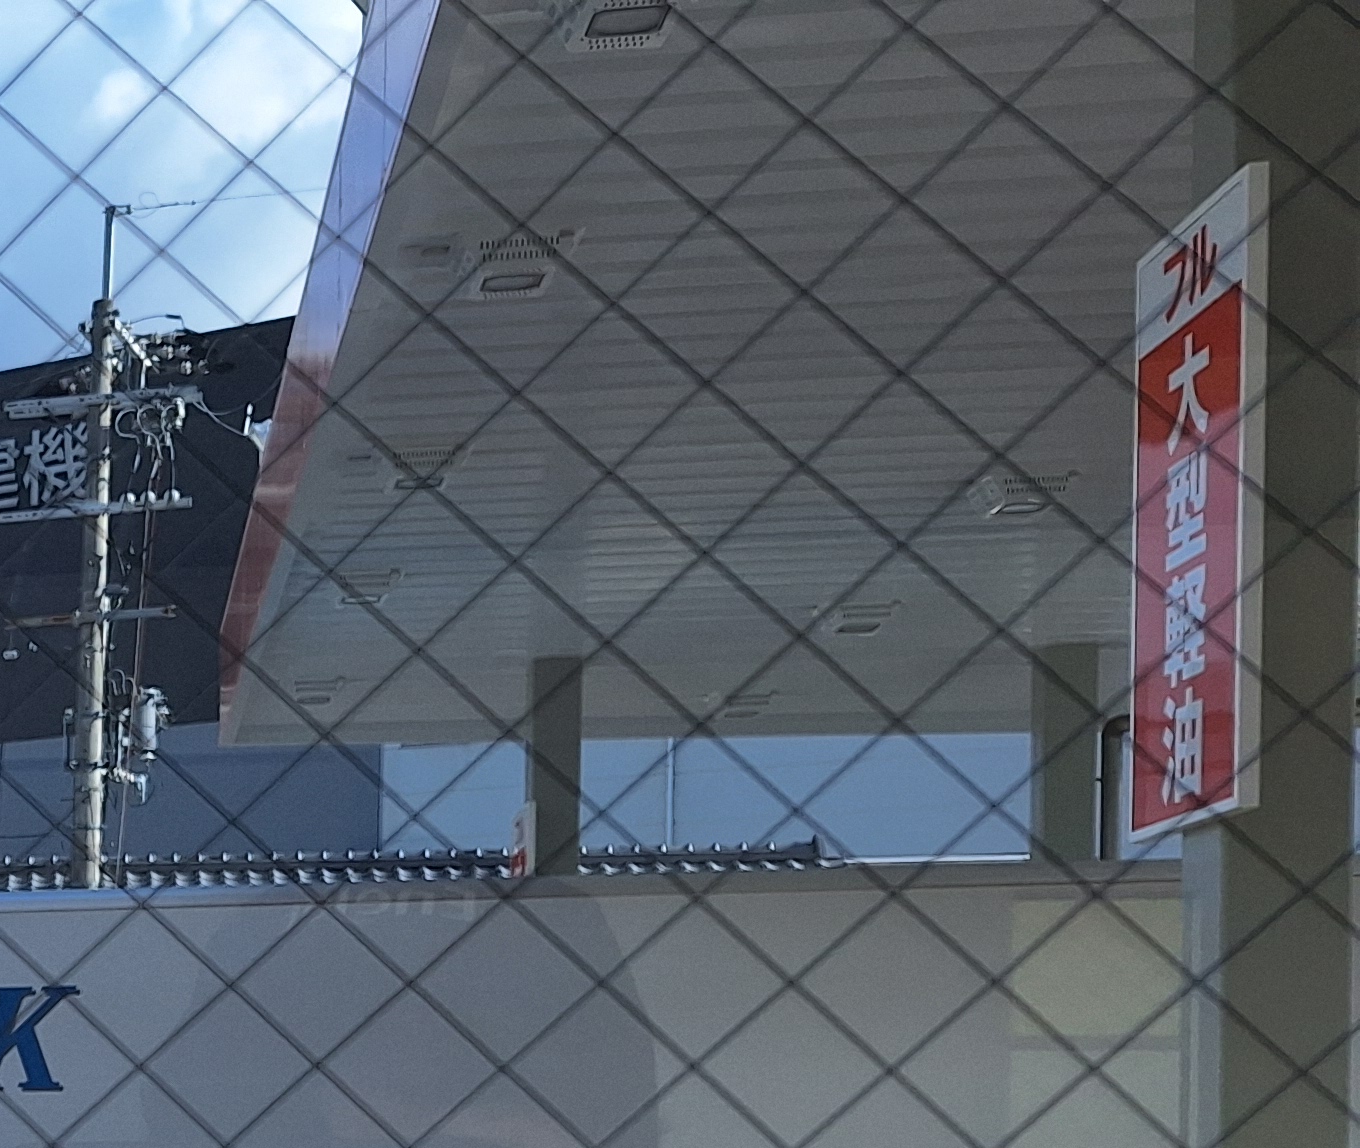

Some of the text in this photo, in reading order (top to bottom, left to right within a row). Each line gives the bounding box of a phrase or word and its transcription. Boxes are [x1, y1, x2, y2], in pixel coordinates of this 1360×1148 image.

[1164, 224, 1217, 322] フル
[1162, 332, 1210, 805] 大型軽油
